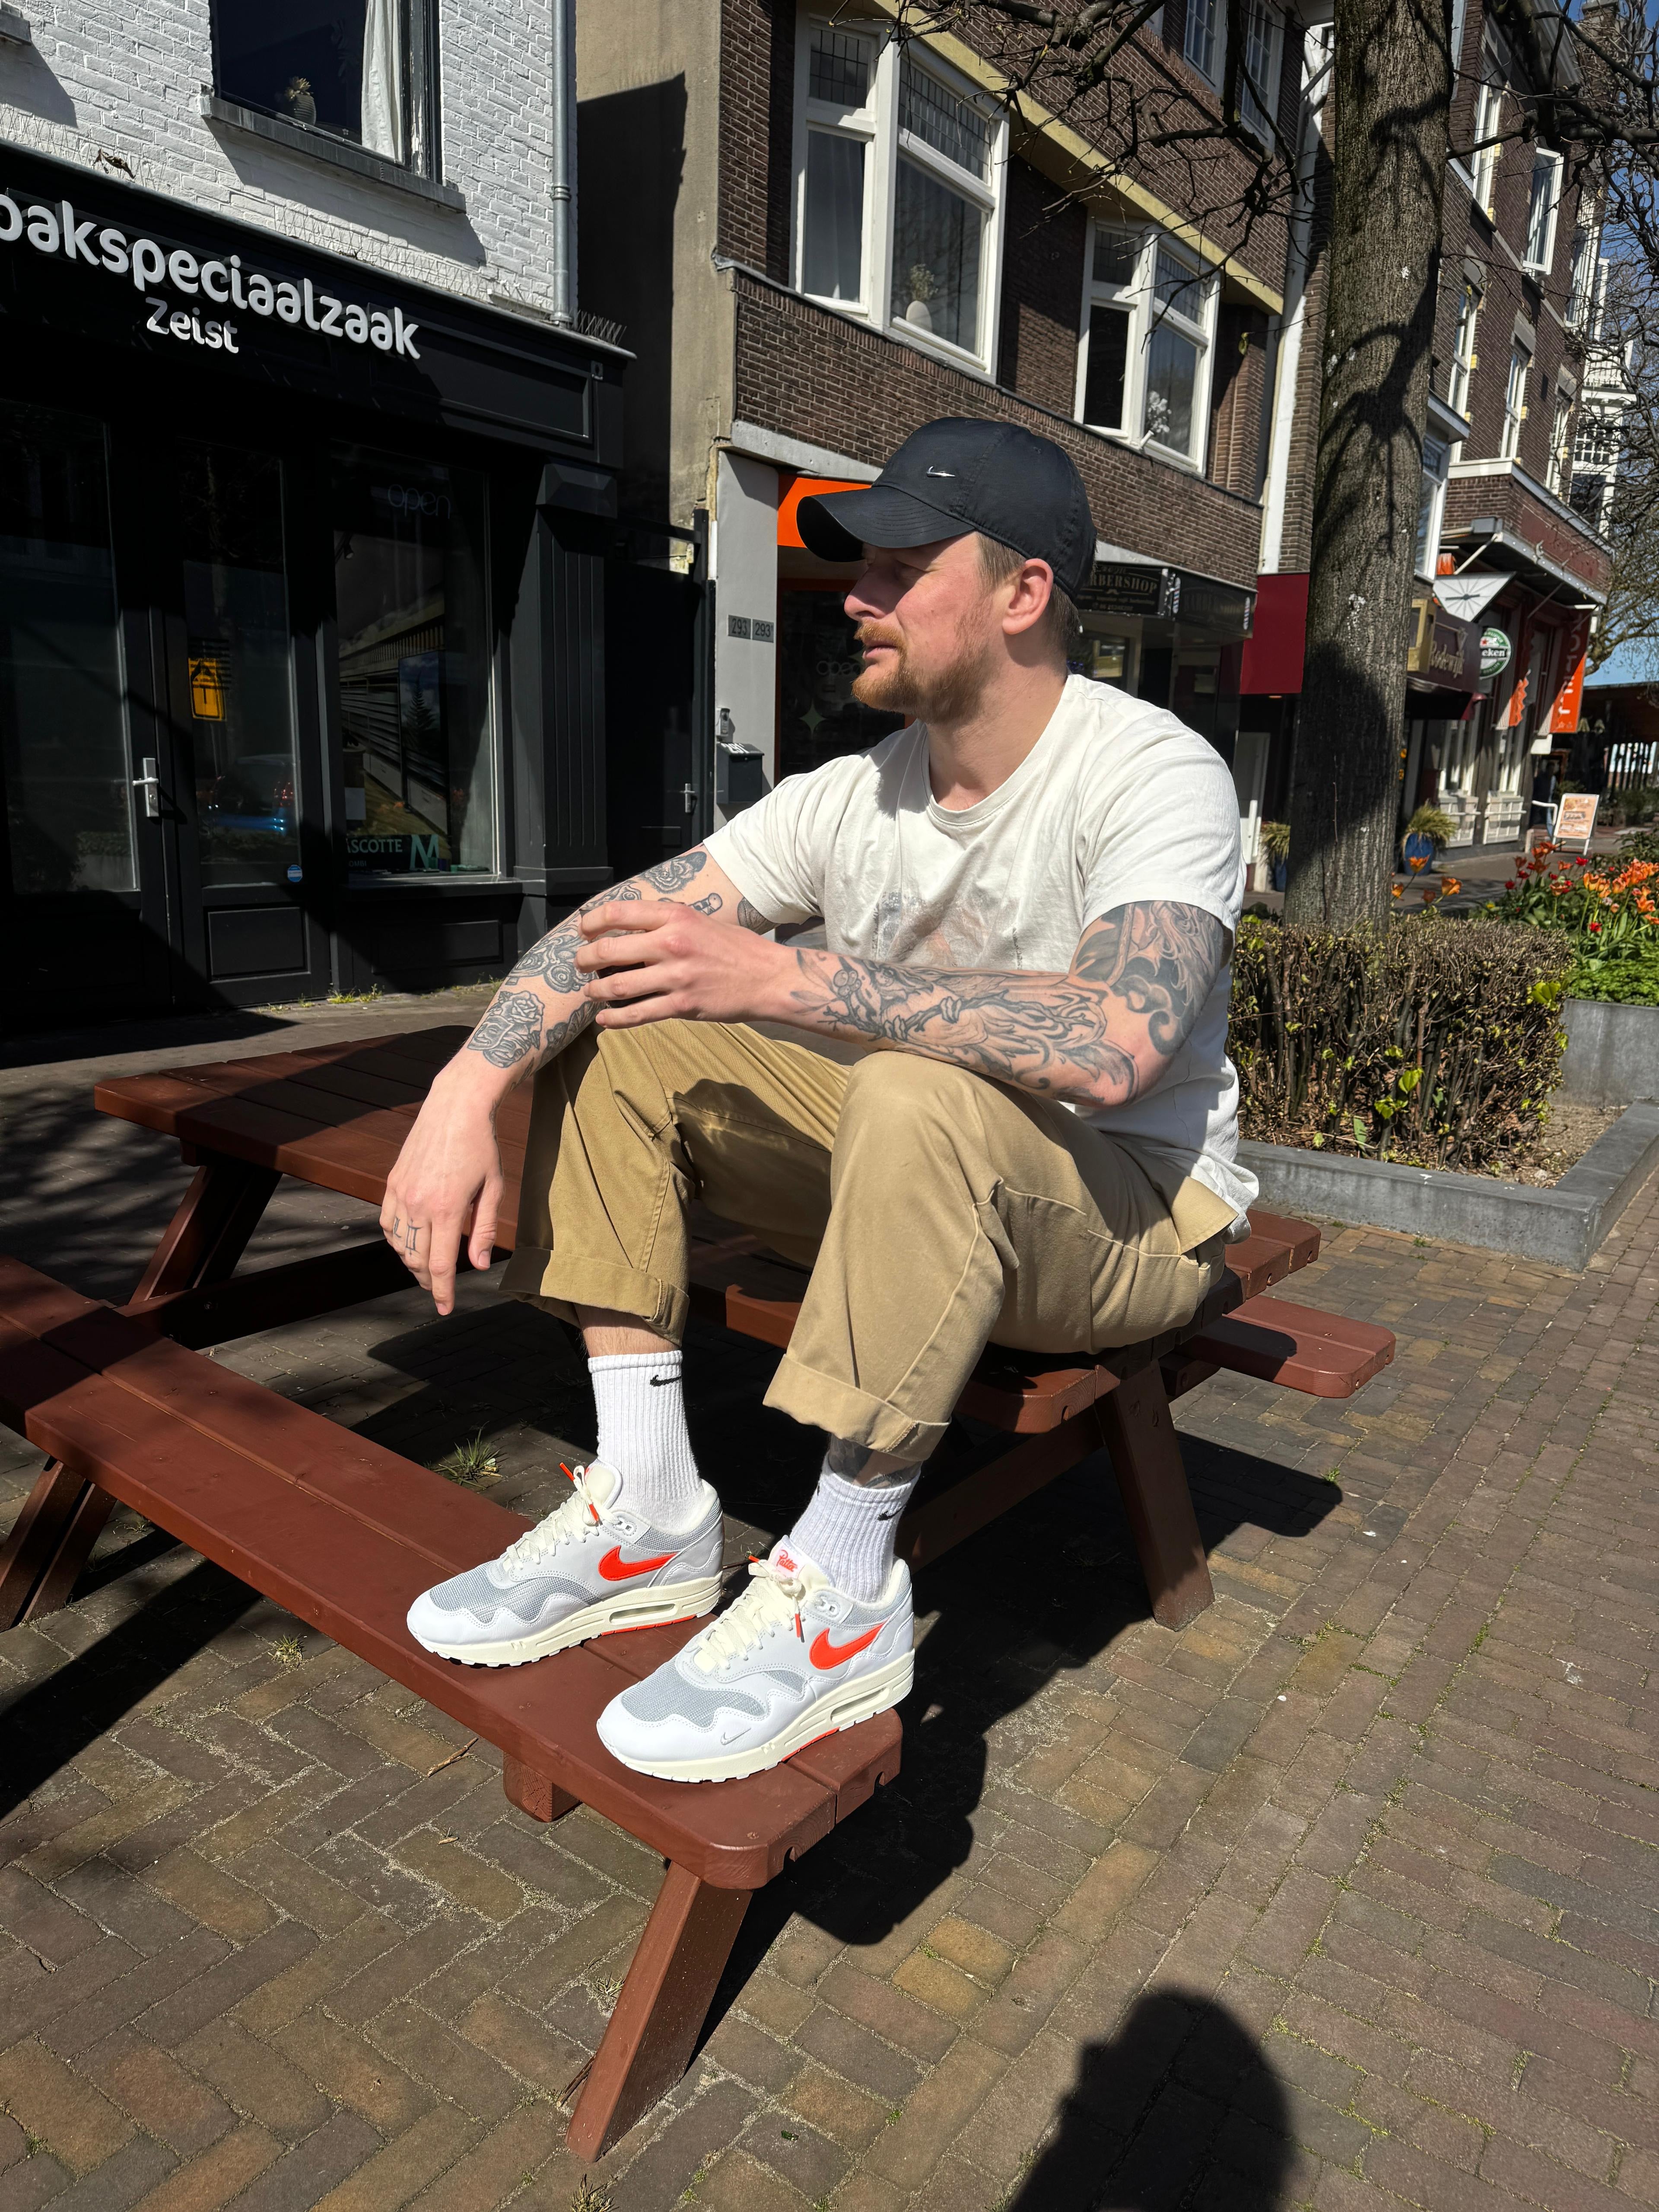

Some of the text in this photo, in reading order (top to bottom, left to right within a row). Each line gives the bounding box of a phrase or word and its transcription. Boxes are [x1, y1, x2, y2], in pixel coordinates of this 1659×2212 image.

[145, 296, 239, 354] Zeist
[387, 483, 451, 520] open
[731, 618, 747, 636] 293
[1481, 648, 1506, 657] eken
[776, 1549, 798, 1573] Patta
